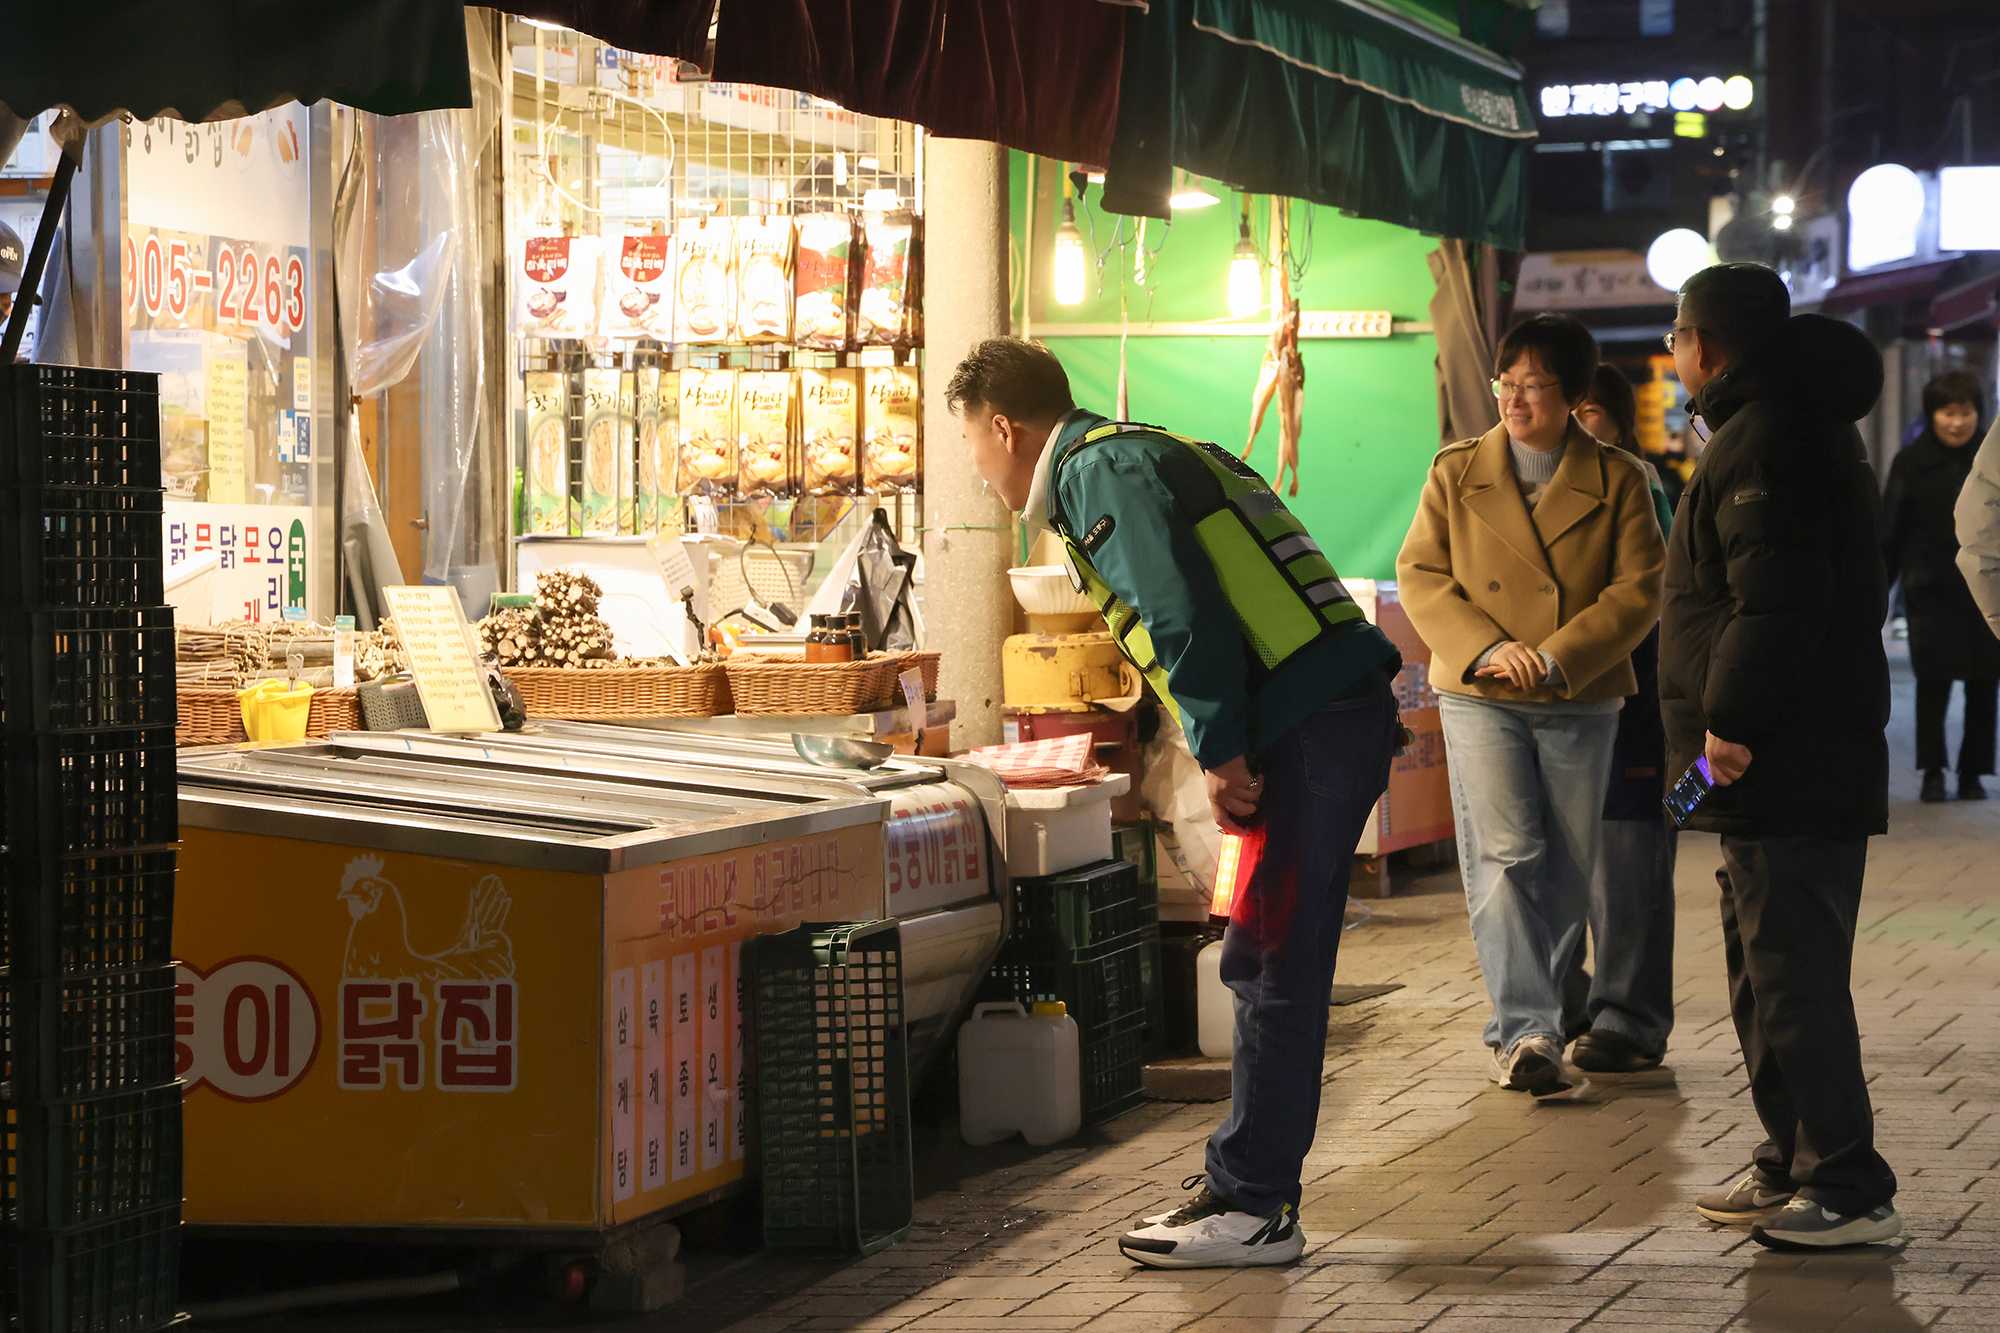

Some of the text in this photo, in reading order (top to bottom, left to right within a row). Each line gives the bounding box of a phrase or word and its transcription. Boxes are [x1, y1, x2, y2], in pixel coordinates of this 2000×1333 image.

[527, 391, 562, 412] 황기
[585, 388, 616, 410] 황기
[685, 387, 728, 407] 삼계탕
[743, 390, 782, 411] 삼계탕
[808, 386, 851, 405] 삼계탕
[870, 385, 911, 405] 삼계탕
[343, 983, 513, 1086] 닭집
[708, 982, 718, 1154] 생오리
[649, 999, 659, 1177] 육계닭
[679, 993, 689, 1166] 토종닭
[617, 1006, 628, 1188] 삼계탕
